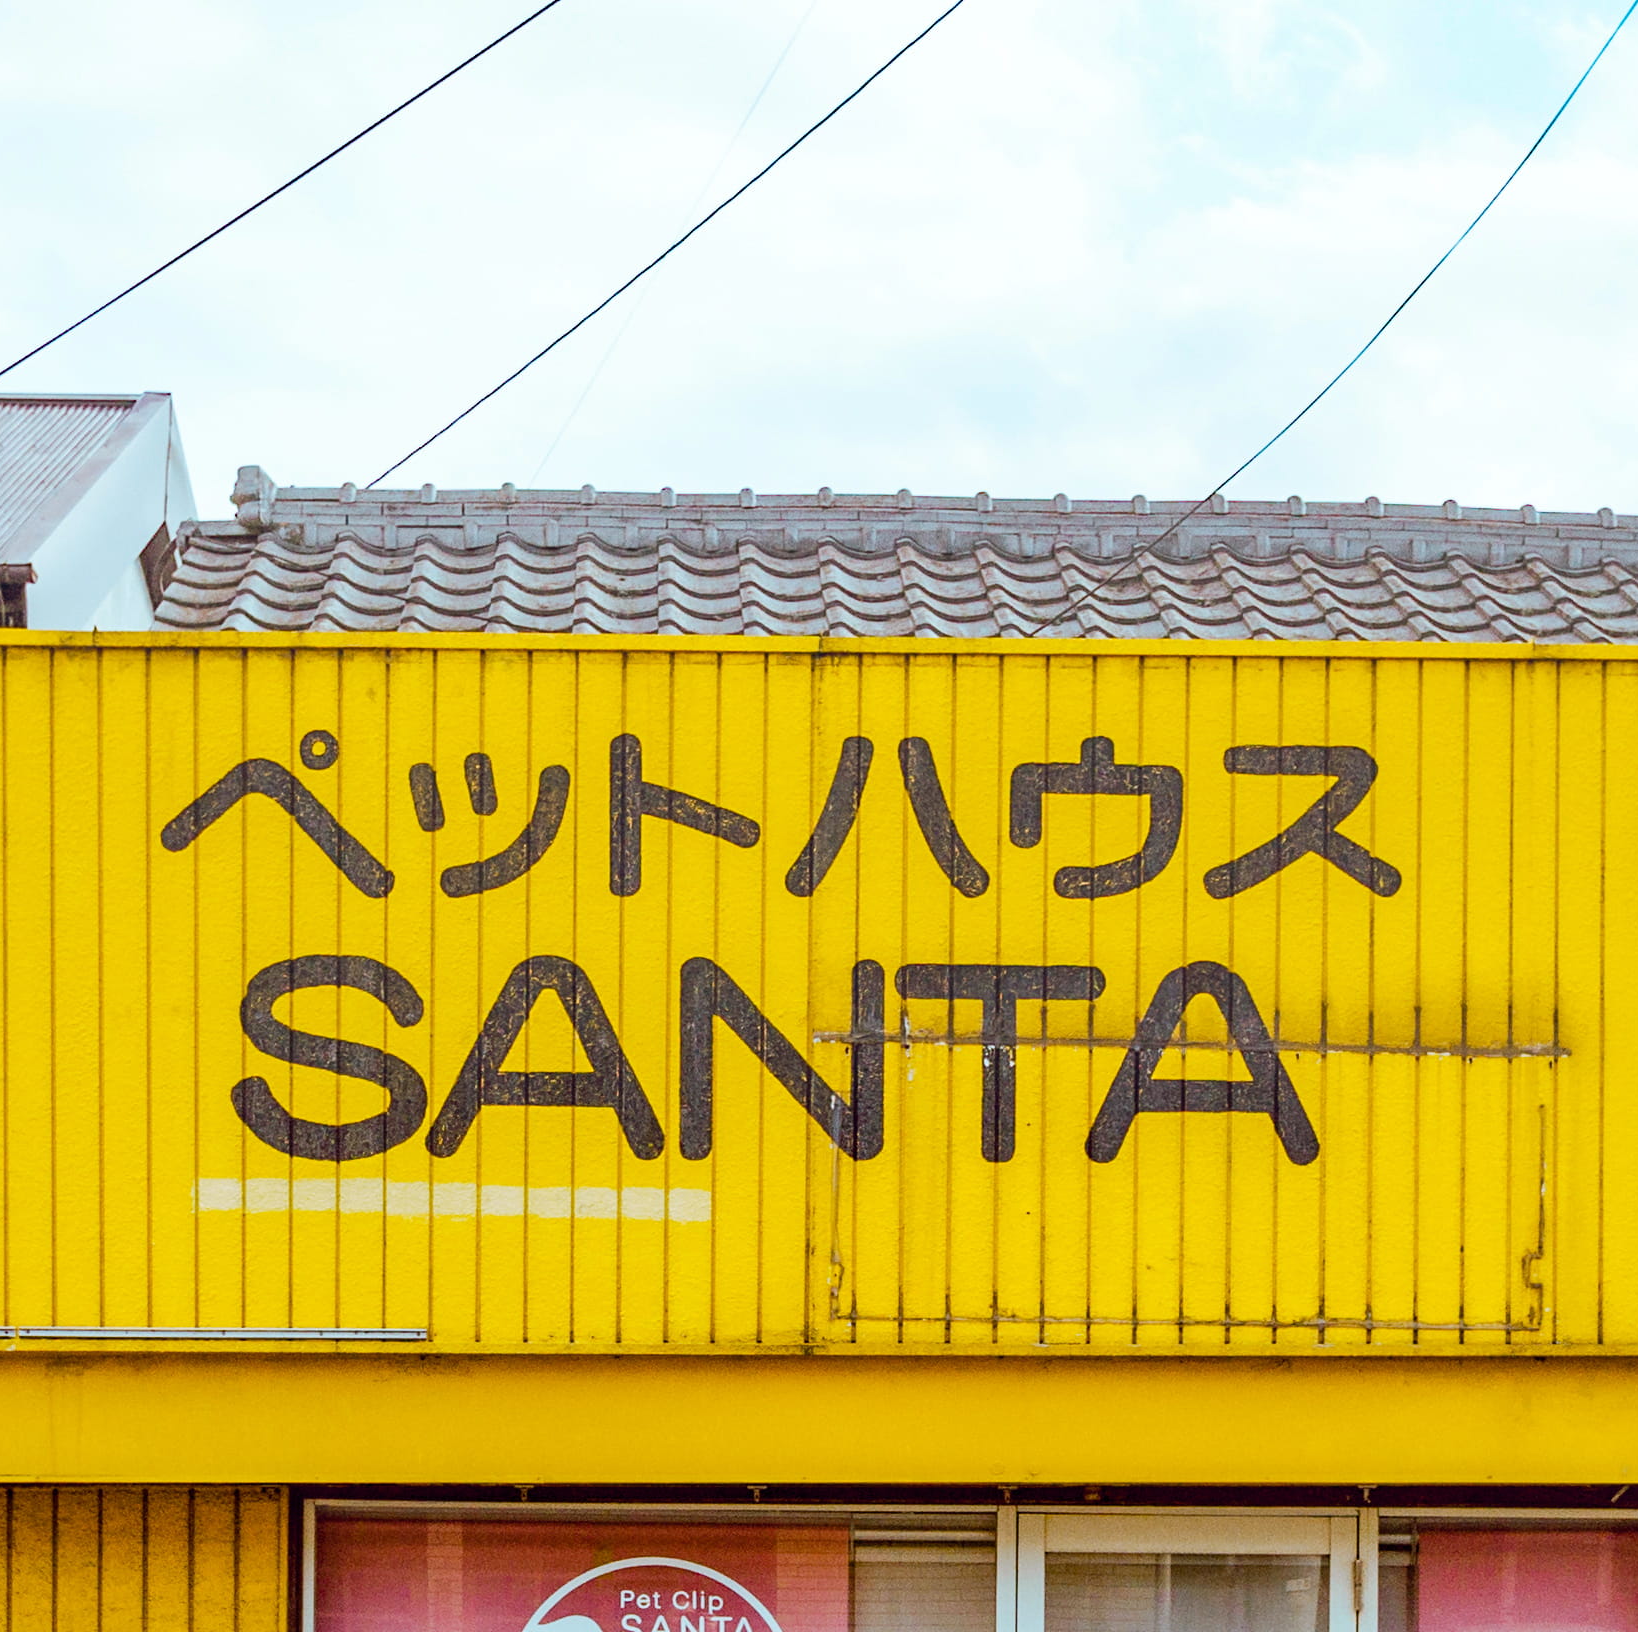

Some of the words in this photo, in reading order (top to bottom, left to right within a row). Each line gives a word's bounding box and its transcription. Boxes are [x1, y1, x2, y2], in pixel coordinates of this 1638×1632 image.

[160, 729, 1404, 900] ペットハウス
[230, 953, 1322, 1165] SANTA
[619, 1590, 662, 1609] Pet
[671, 1590, 725, 1615] Clip
